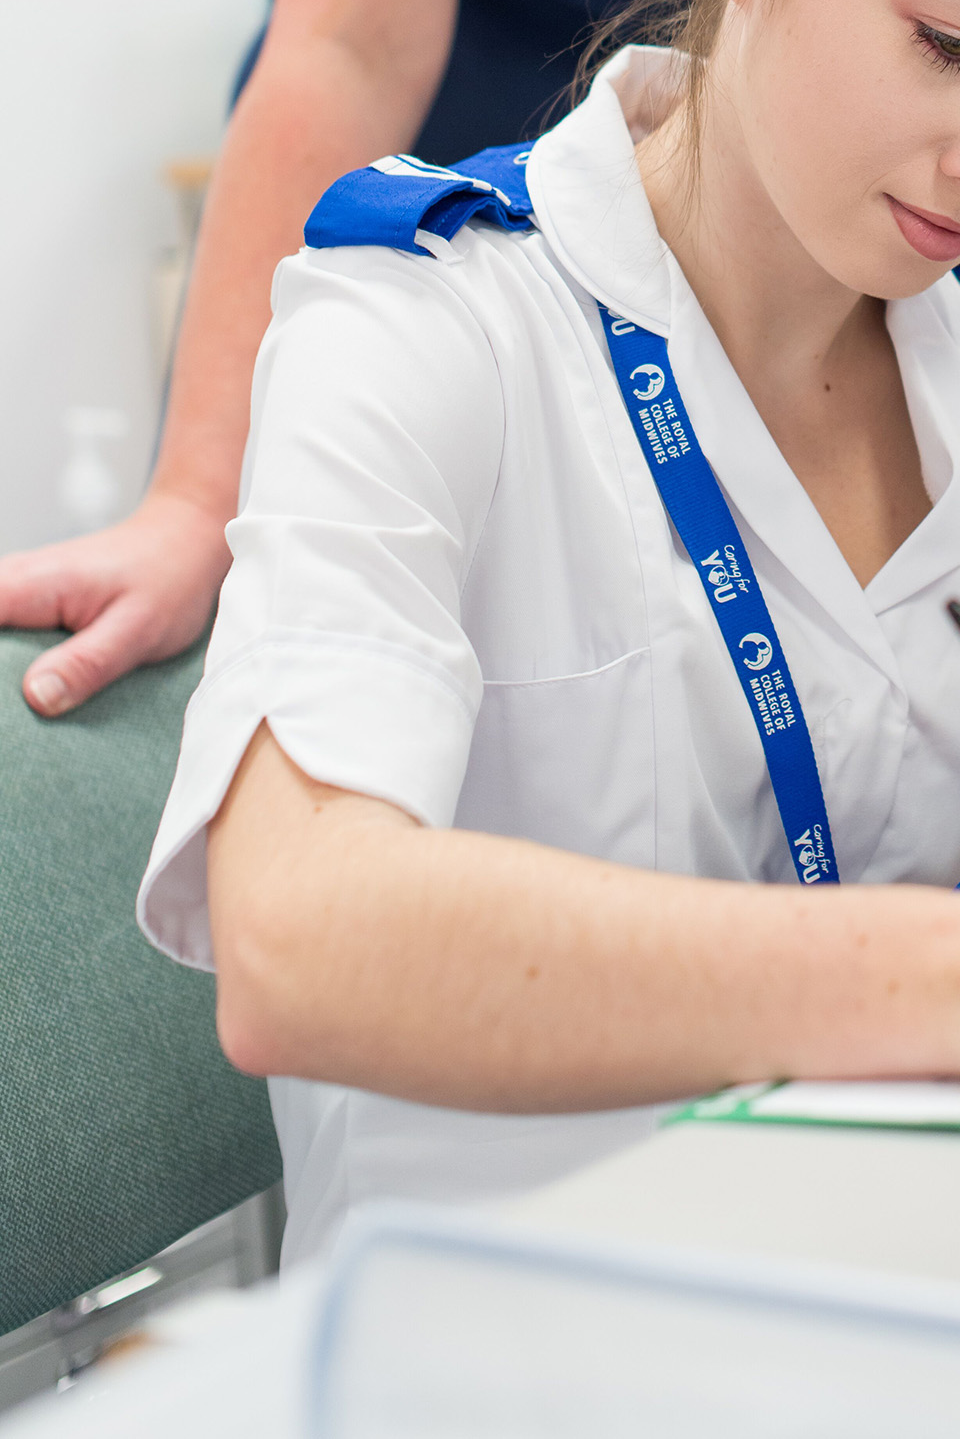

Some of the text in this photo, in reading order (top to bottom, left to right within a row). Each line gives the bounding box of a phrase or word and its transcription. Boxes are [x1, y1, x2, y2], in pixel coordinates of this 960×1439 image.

[637, 408, 668, 465] MIDWIVES
[649, 403, 682, 459] COLLEGE OF
[662, 398, 692, 456] THE ROYAL
[723, 544, 751, 594] Caring for
[749, 677, 776, 737] MIDWIVES
[760, 674, 788, 732] COLLEGE OF
[771, 669, 797, 728] THE ROYAL
[813, 823, 831, 875] Caring for
